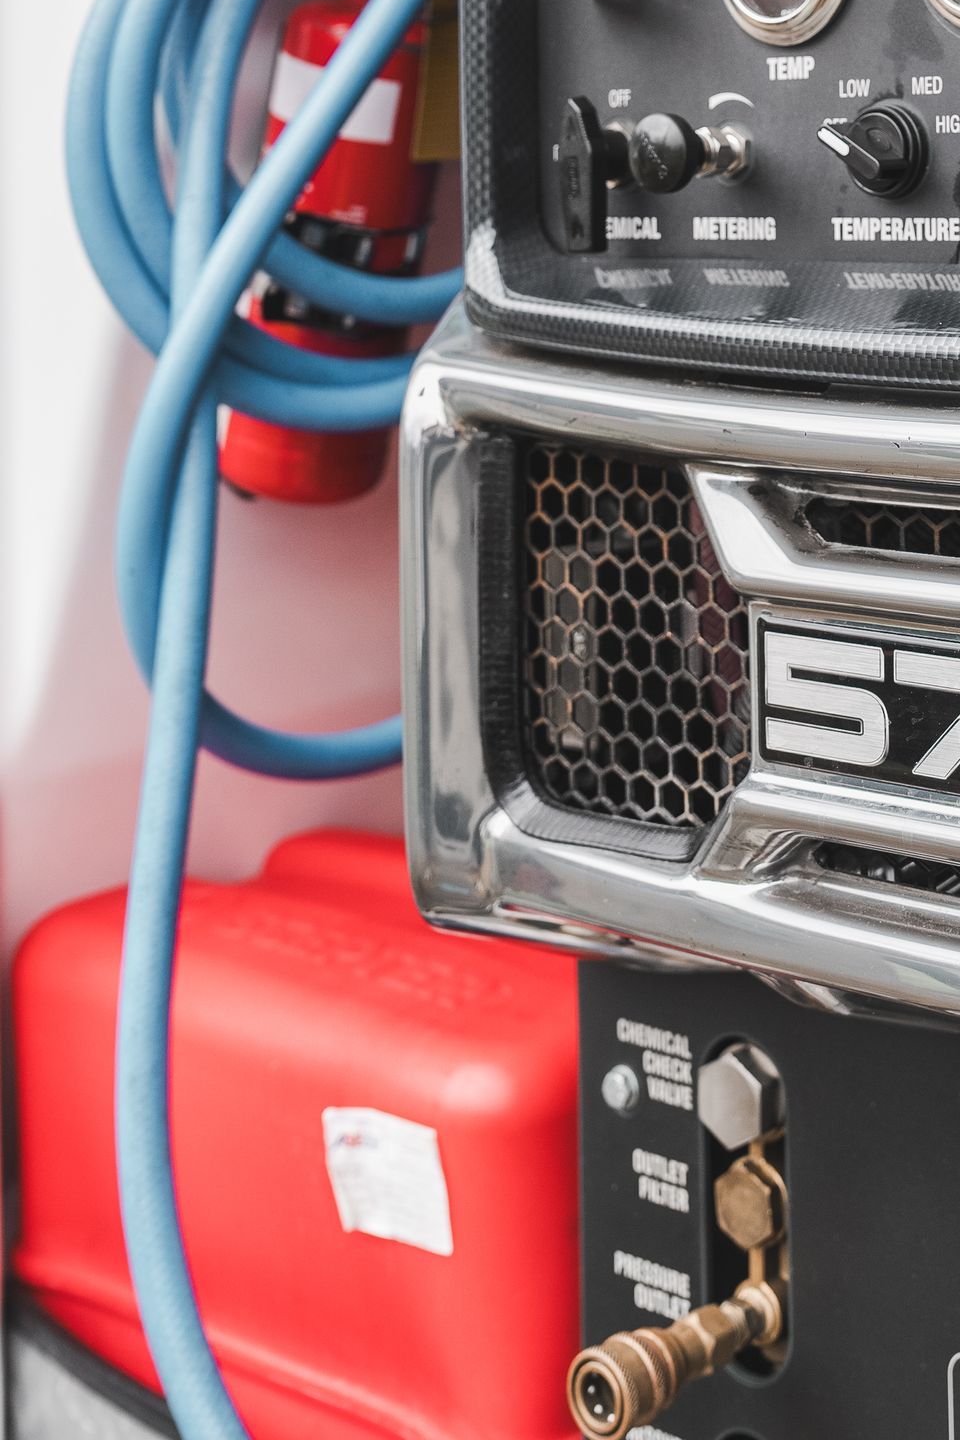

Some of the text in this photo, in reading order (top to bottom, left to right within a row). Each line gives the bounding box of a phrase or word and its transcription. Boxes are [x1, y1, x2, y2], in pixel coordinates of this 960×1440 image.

[766, 56, 815, 81] TEMP
[607, 88, 632, 109] OFF
[838, 78, 871, 99] LOW
[911, 75, 944, 96] MED
[692, 216, 777, 241] METERING
[831, 216, 960, 242] TEMPERATURE
[617, 1017, 692, 1058] CHEMICAL
[642, 1049, 693, 1086] CHECK
[632, 1148, 689, 1187] OUTLET
[638, 1175, 690, 1213] FILTER
[613, 1250, 691, 1298] PRESSURE
